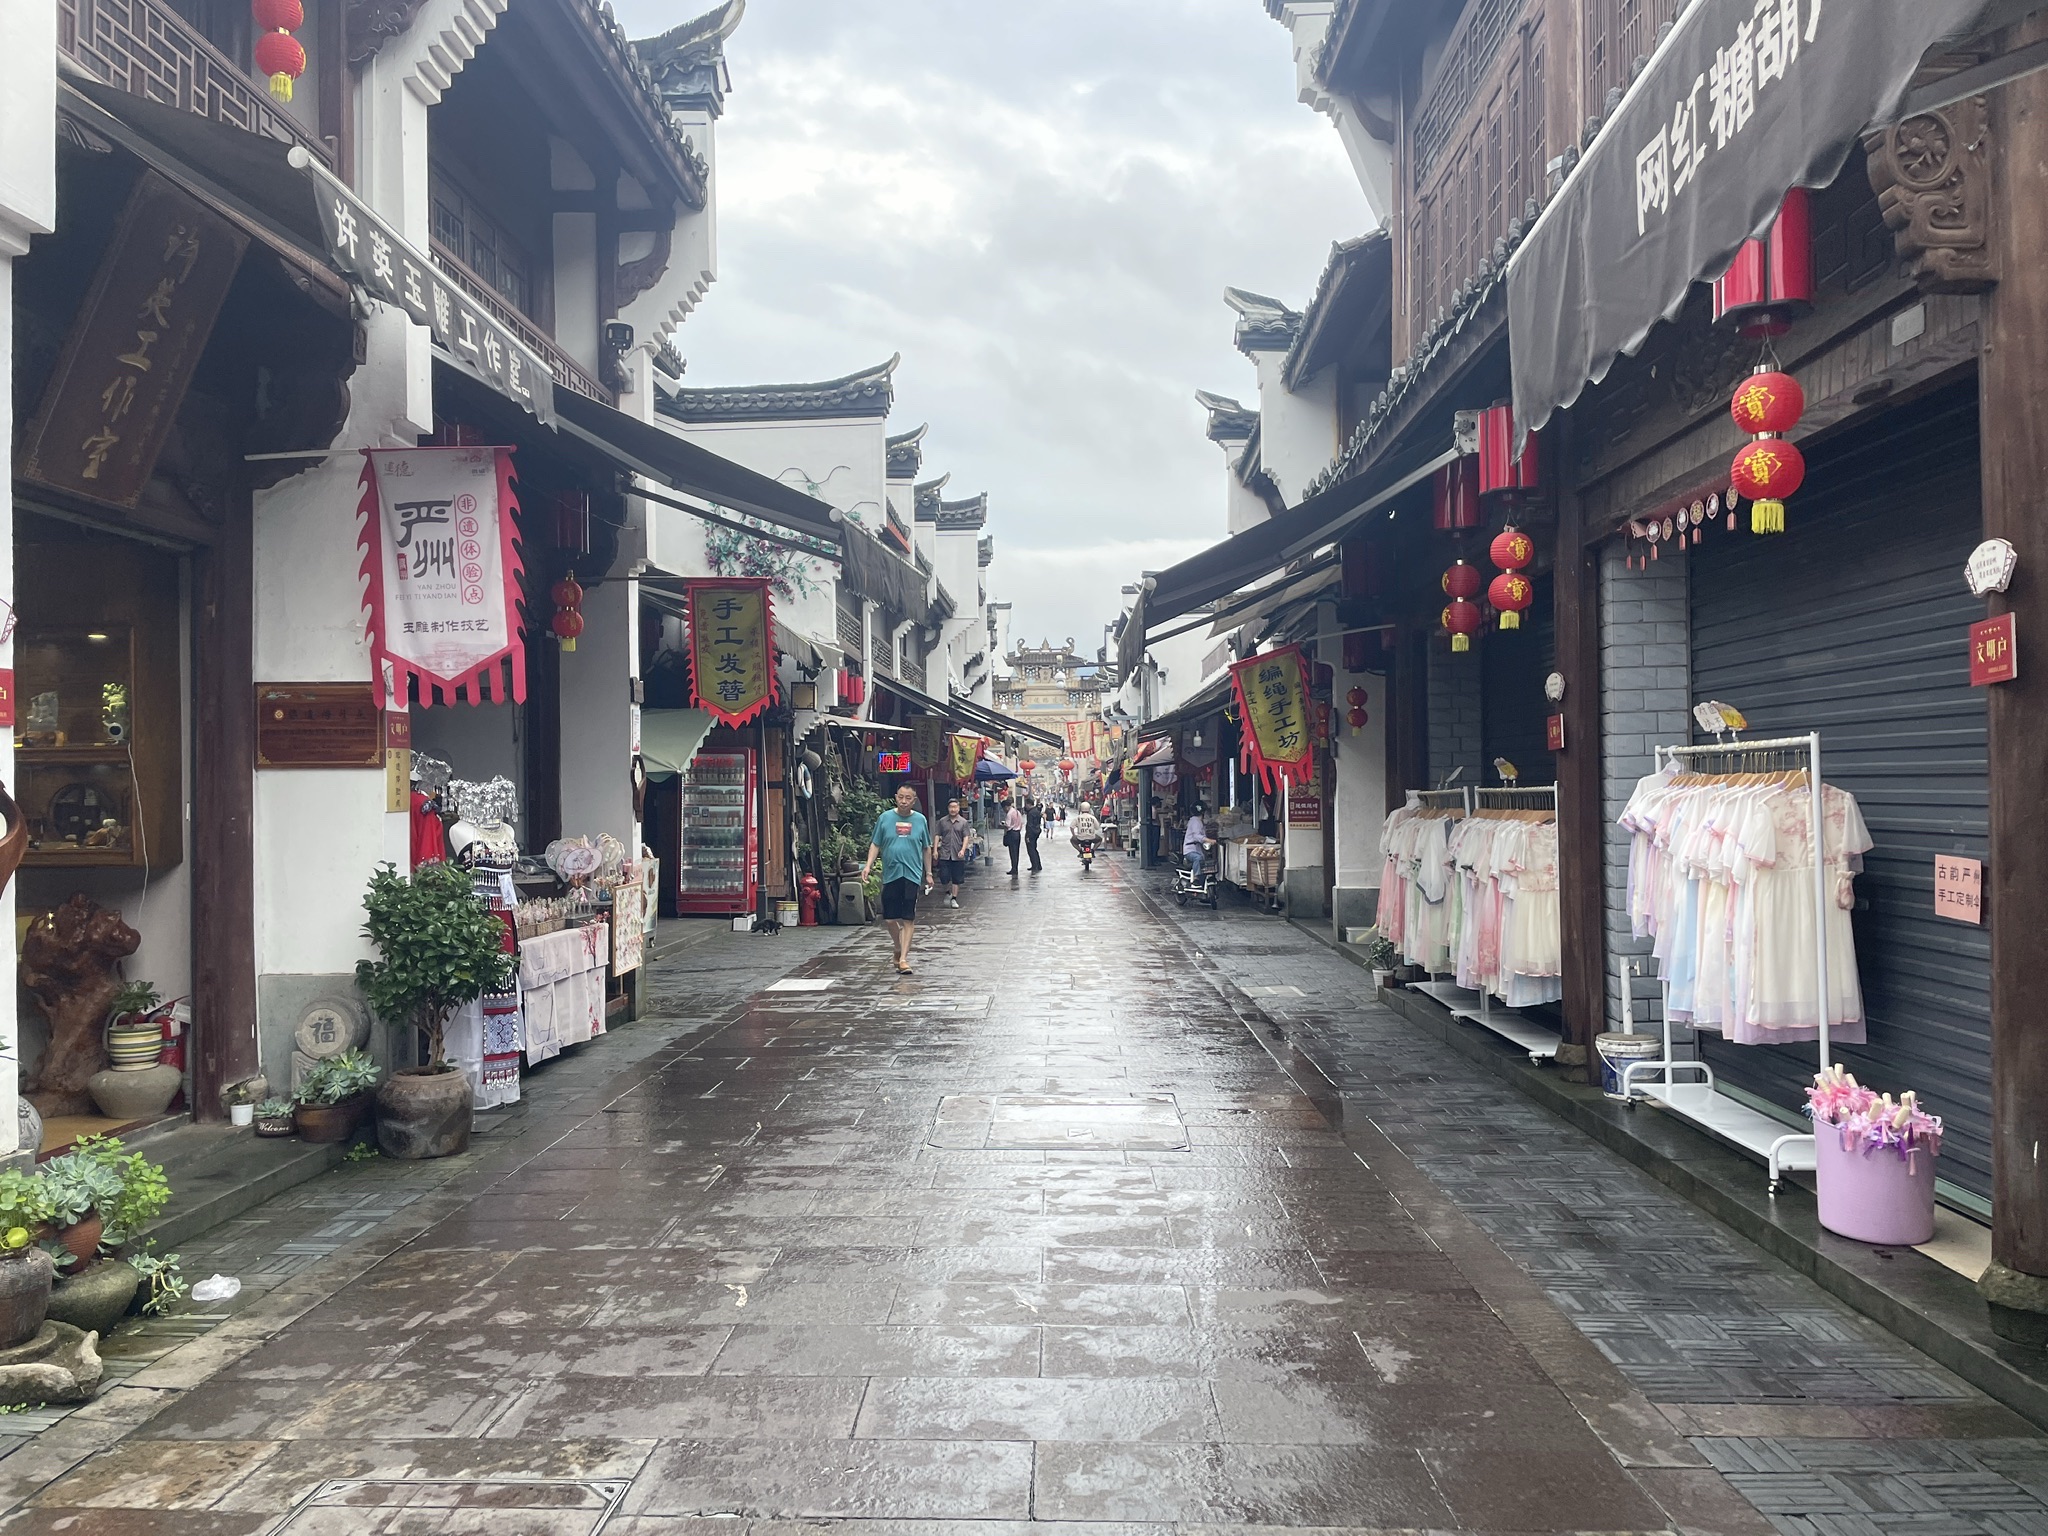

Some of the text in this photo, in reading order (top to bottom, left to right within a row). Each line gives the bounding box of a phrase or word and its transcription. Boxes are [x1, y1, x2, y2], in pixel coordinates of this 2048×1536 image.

[1636, 0, 1822, 237] 网红糖葫
[334, 198, 524, 394] 许英玉雕工作室
[394, 500, 456, 579] 严州
[457, 494, 484, 604] 非遗体验点
[403, 619, 489, 634] 玉雕制作技艺
[712, 597, 746, 702] 手工发簪
[1976, 636, 2007, 664] 文明户
[1258, 665, 1300, 749] 编绳手工坊
[882, 754, 909, 770] 烟酒
[309, 1016, 336, 1044] 福
[257, 1121, 290, 1132] Welcome
